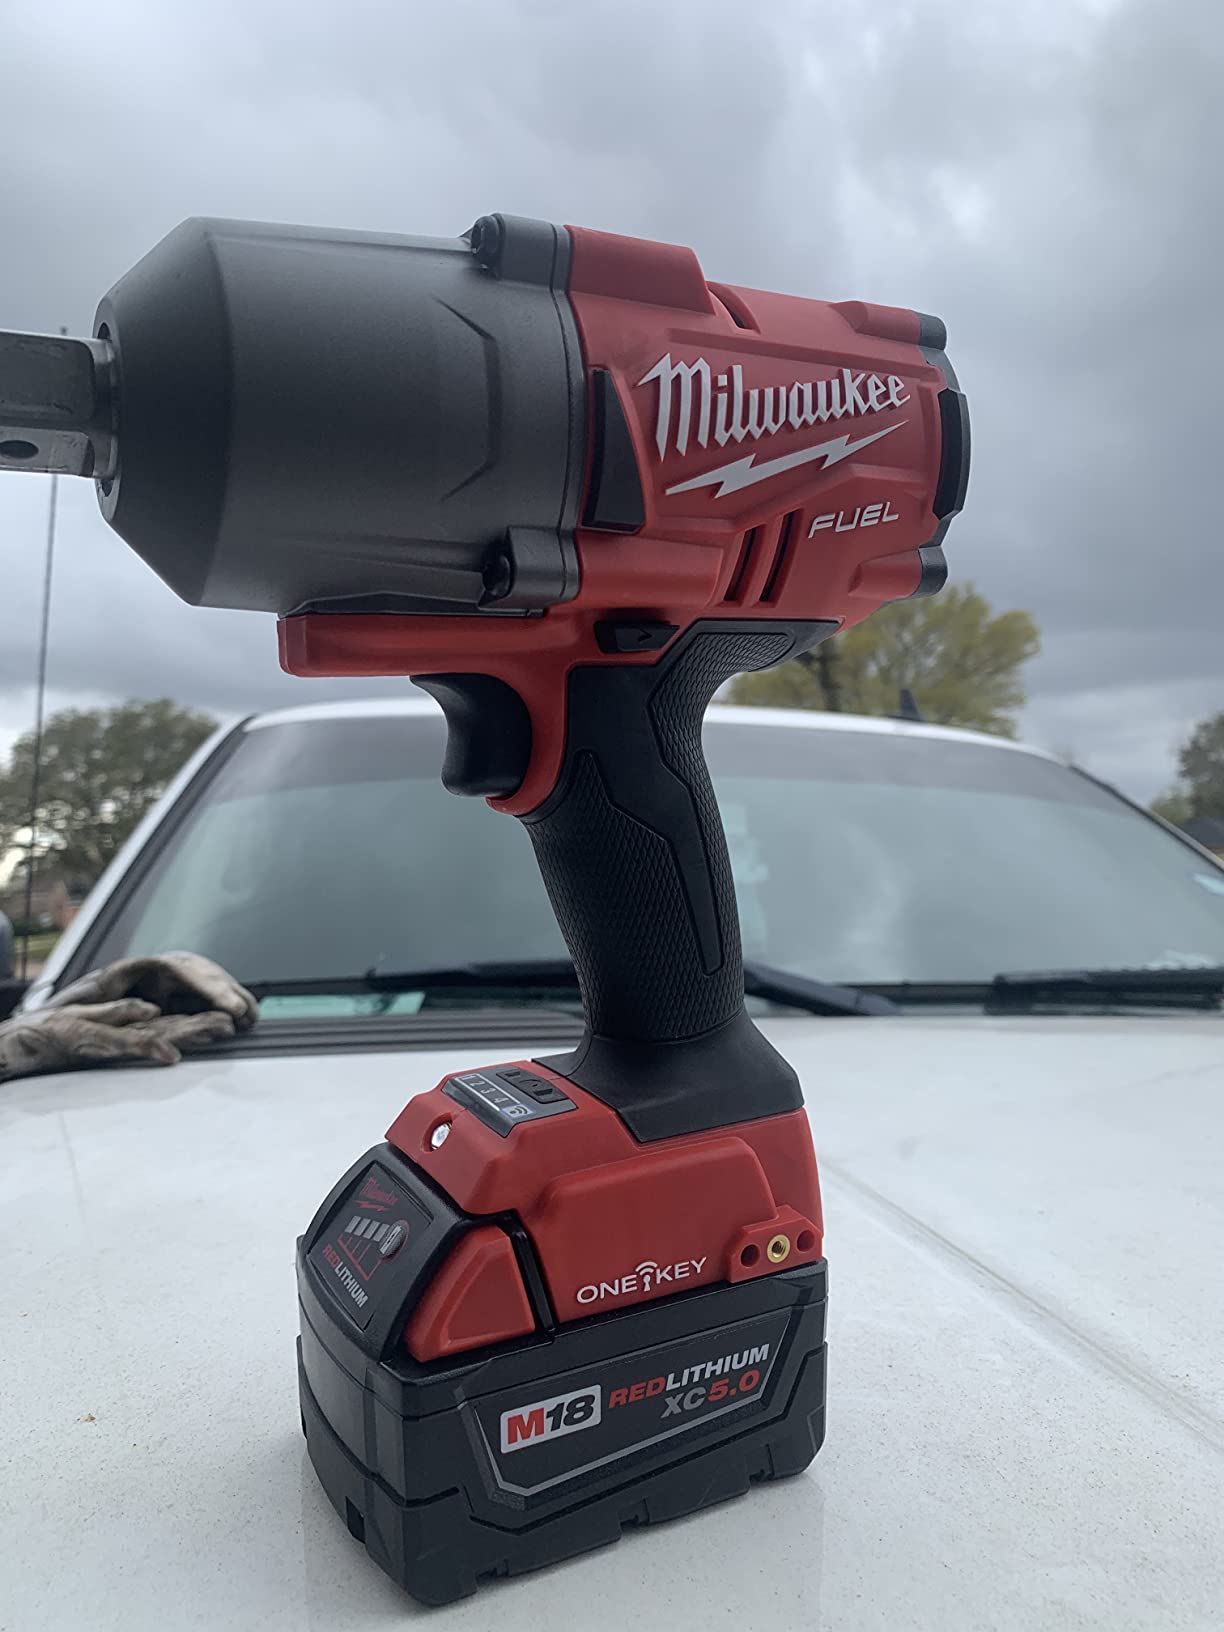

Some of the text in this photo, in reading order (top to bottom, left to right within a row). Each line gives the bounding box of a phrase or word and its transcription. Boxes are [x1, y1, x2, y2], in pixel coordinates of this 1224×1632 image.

[636, 352, 911, 462] Milwaukee
[808, 501, 899, 539] FUEL
[322, 1242, 369, 1308] REDLITHIUM
[608, 1343, 771, 1408] REDLITHIUM
[507, 1393, 595, 1445] M18
